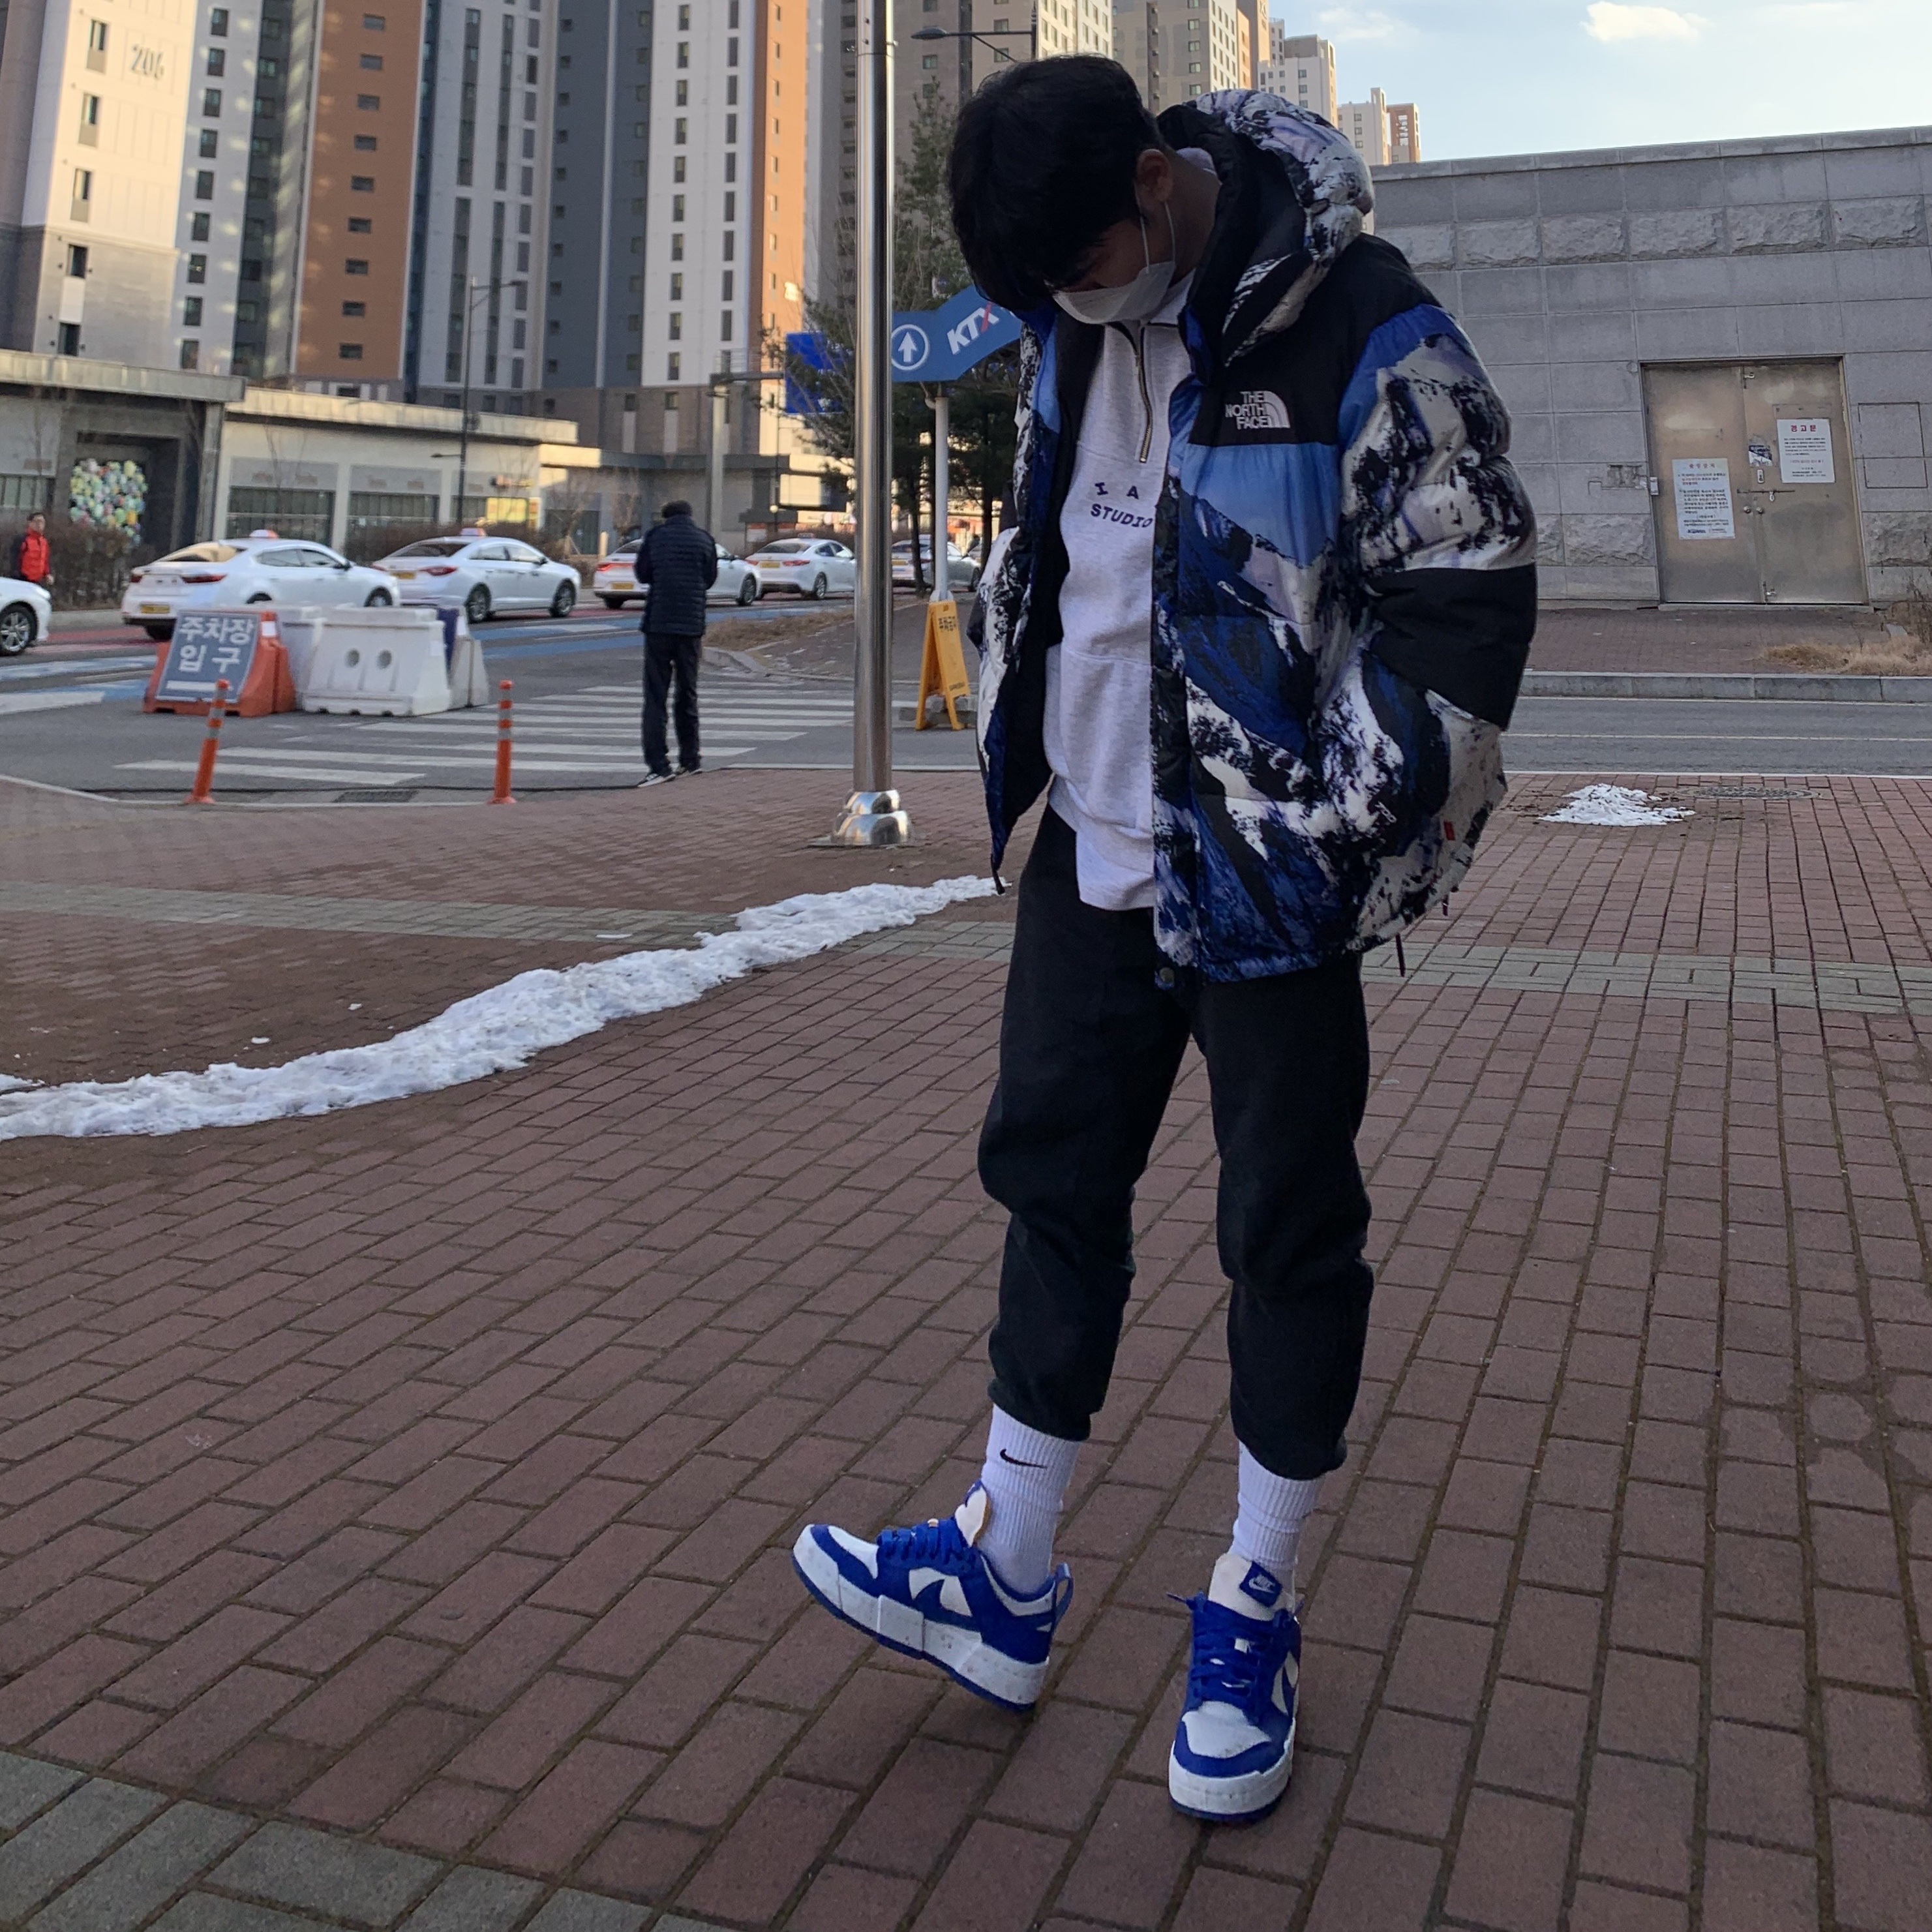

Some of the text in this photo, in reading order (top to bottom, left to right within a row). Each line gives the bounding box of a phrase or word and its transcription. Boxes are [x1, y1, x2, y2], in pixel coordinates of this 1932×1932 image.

[130, 44, 165, 80] 206
[946, 301, 1000, 355] KTX
[1225, 403, 1267, 417] NORTH
[1239, 391, 1265, 404] THE
[1236, 416, 1270, 430] FACE
[1091, 503, 1153, 528] STUDIO
[179, 616, 254, 645] 주차장
